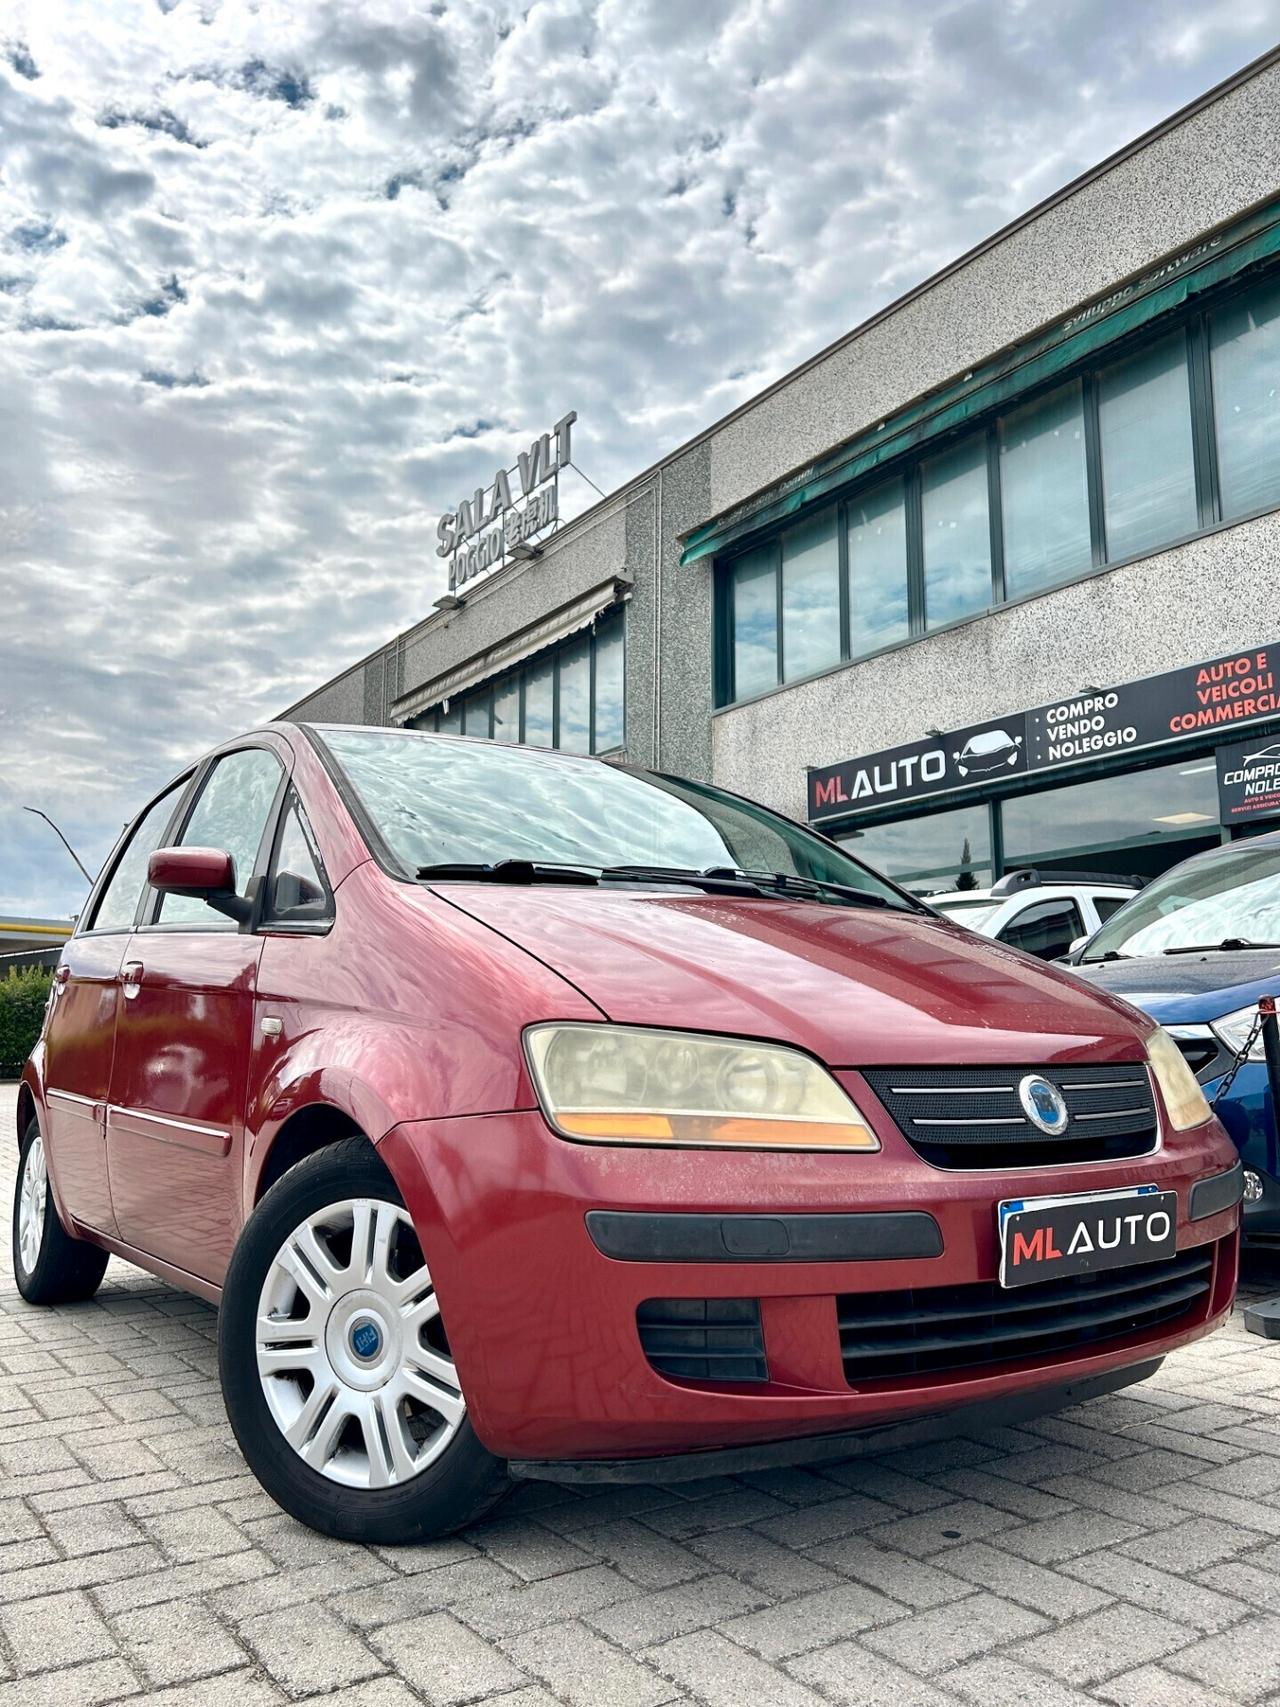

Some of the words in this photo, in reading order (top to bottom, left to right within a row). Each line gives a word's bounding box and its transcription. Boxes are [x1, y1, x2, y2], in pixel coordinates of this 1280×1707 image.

[436, 468, 513, 558] SALA
[518, 410, 577, 495] VLT
[448, 527, 504, 591] POGGIO
[1196, 657, 1251, 686] AUTO
[1256, 652, 1267, 670] E
[1195, 672, 1273, 705] VEICOLI
[1046, 692, 1119, 724] COMPRO
[1169, 693, 1280, 733] COMMERCI
[1046, 715, 1105, 742] VENDO
[1047, 726, 1137, 761] NOLEGGIO
[815, 775, 849, 808] ML
[851, 749, 946, 800] AUTO
[1012, 1226, 1063, 1266] ML
[1066, 1211, 1171, 1256] AUTO
